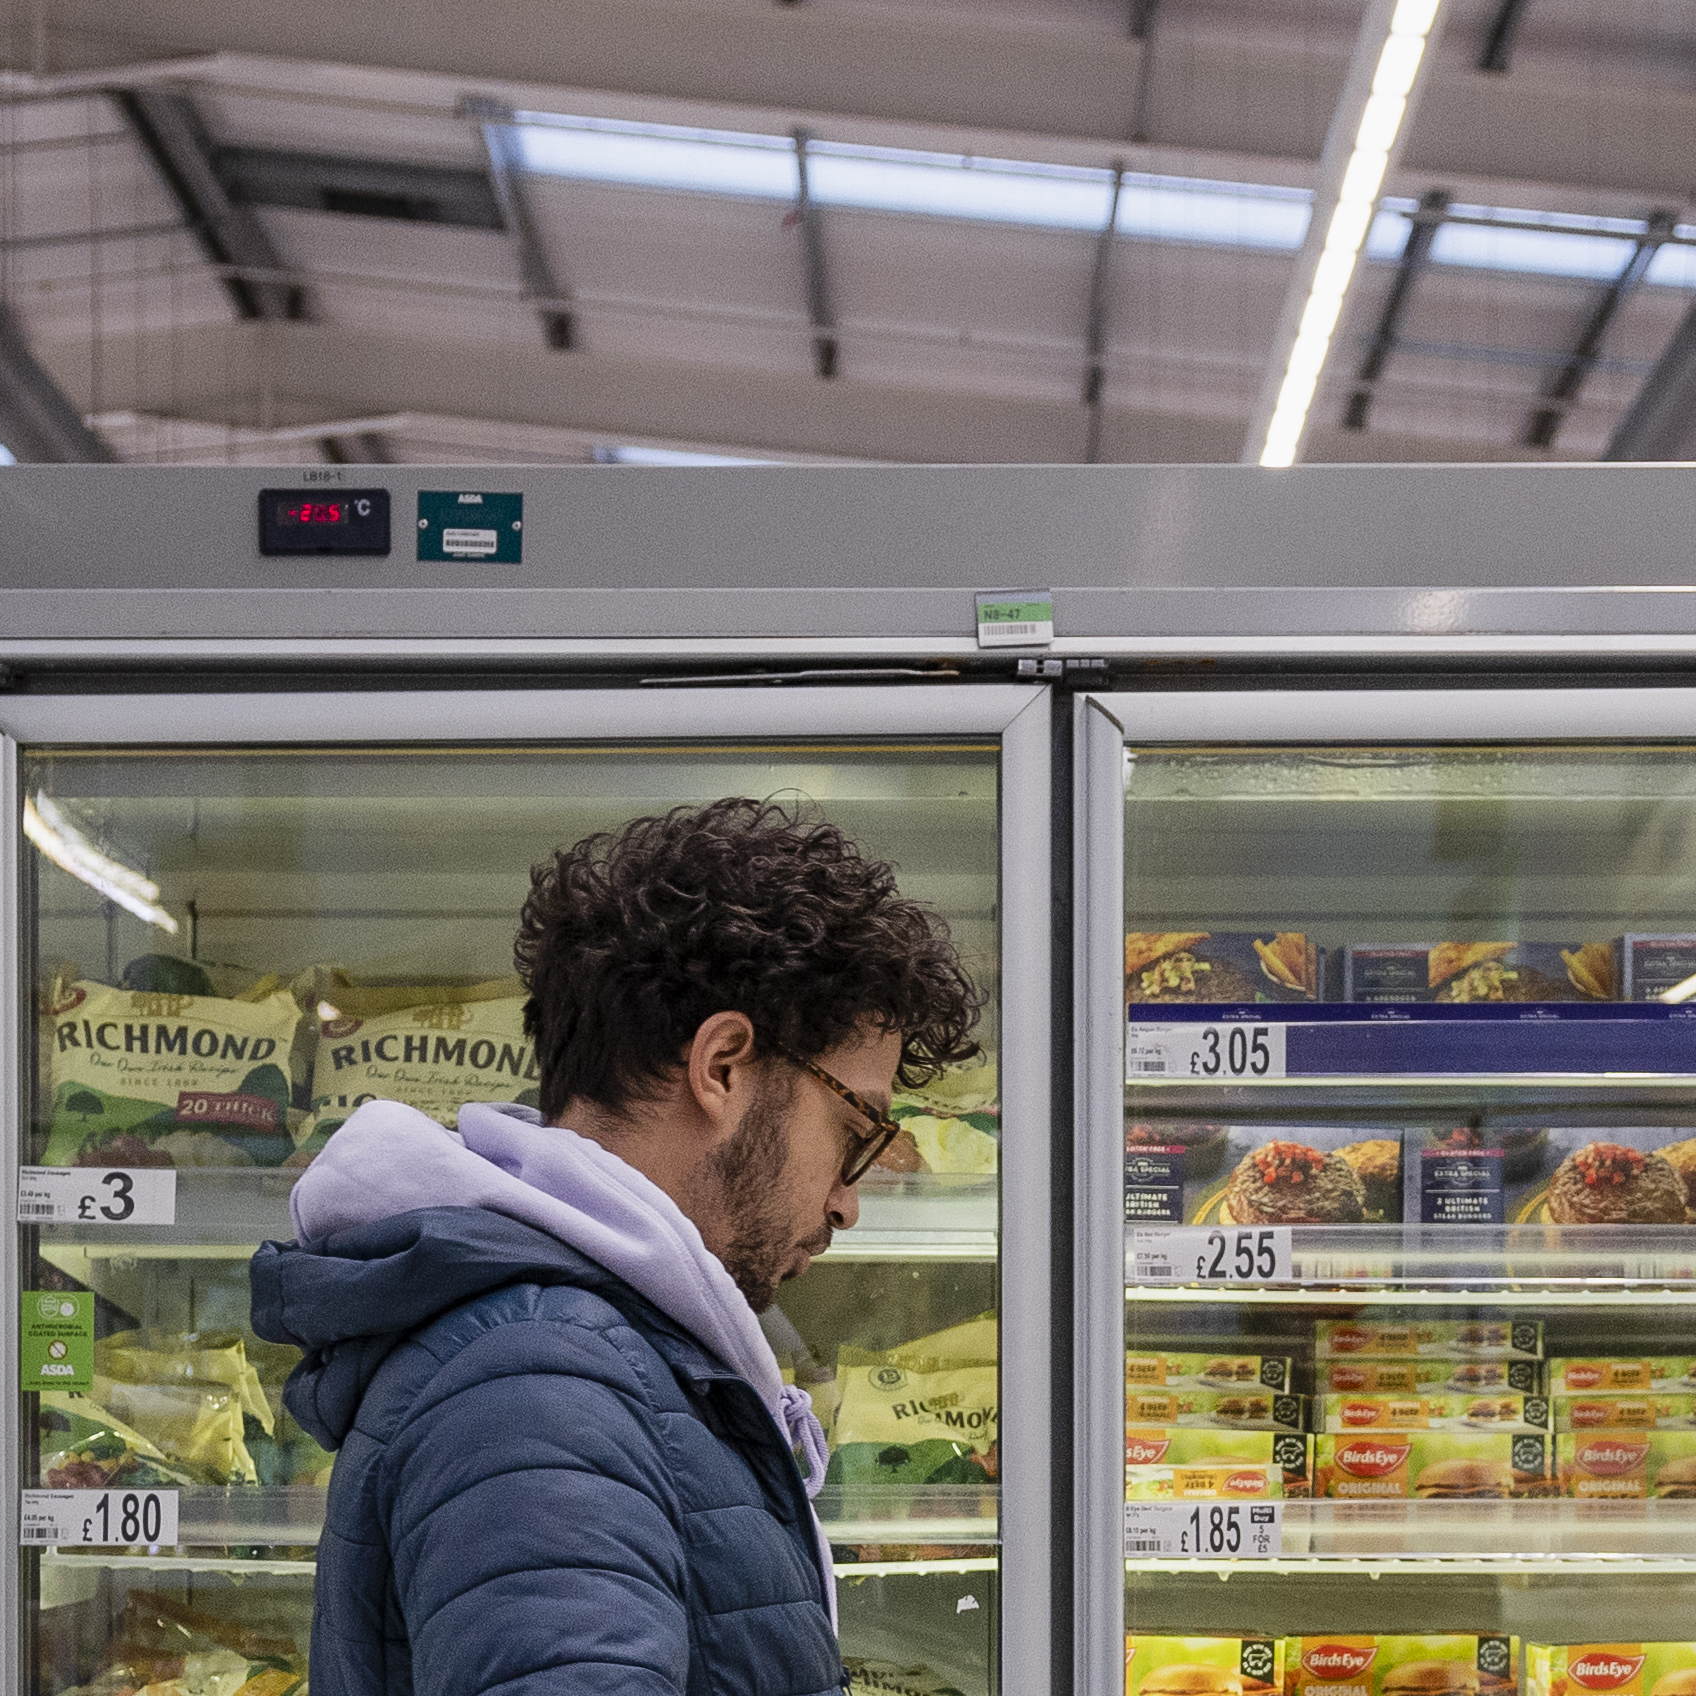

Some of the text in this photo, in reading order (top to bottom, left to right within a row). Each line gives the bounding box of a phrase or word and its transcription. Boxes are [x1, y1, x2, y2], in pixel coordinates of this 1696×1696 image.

[57, 1019, 277, 1063] RICHMOND
[1190, 1027, 1270, 1077] £3.05
[180, 1099, 207, 1115] 20
[78, 1171, 135, 1220] £3
[1196, 1231, 1276, 1279] £2.55
[41, 1364, 74, 1375] ASDA
[1343, 1451, 1397, 1466] BirdsEye
[1583, 1448, 1637, 1465] BirdsEye
[82, 1494, 161, 1542] £1.80
[1181, 1506, 1240, 1553] £1.85
[1252, 1535, 1270, 1544] FOR
[1310, 1653, 1365, 1669] BirdsEye
[1577, 1662, 1631, 1677] BirdsEye
